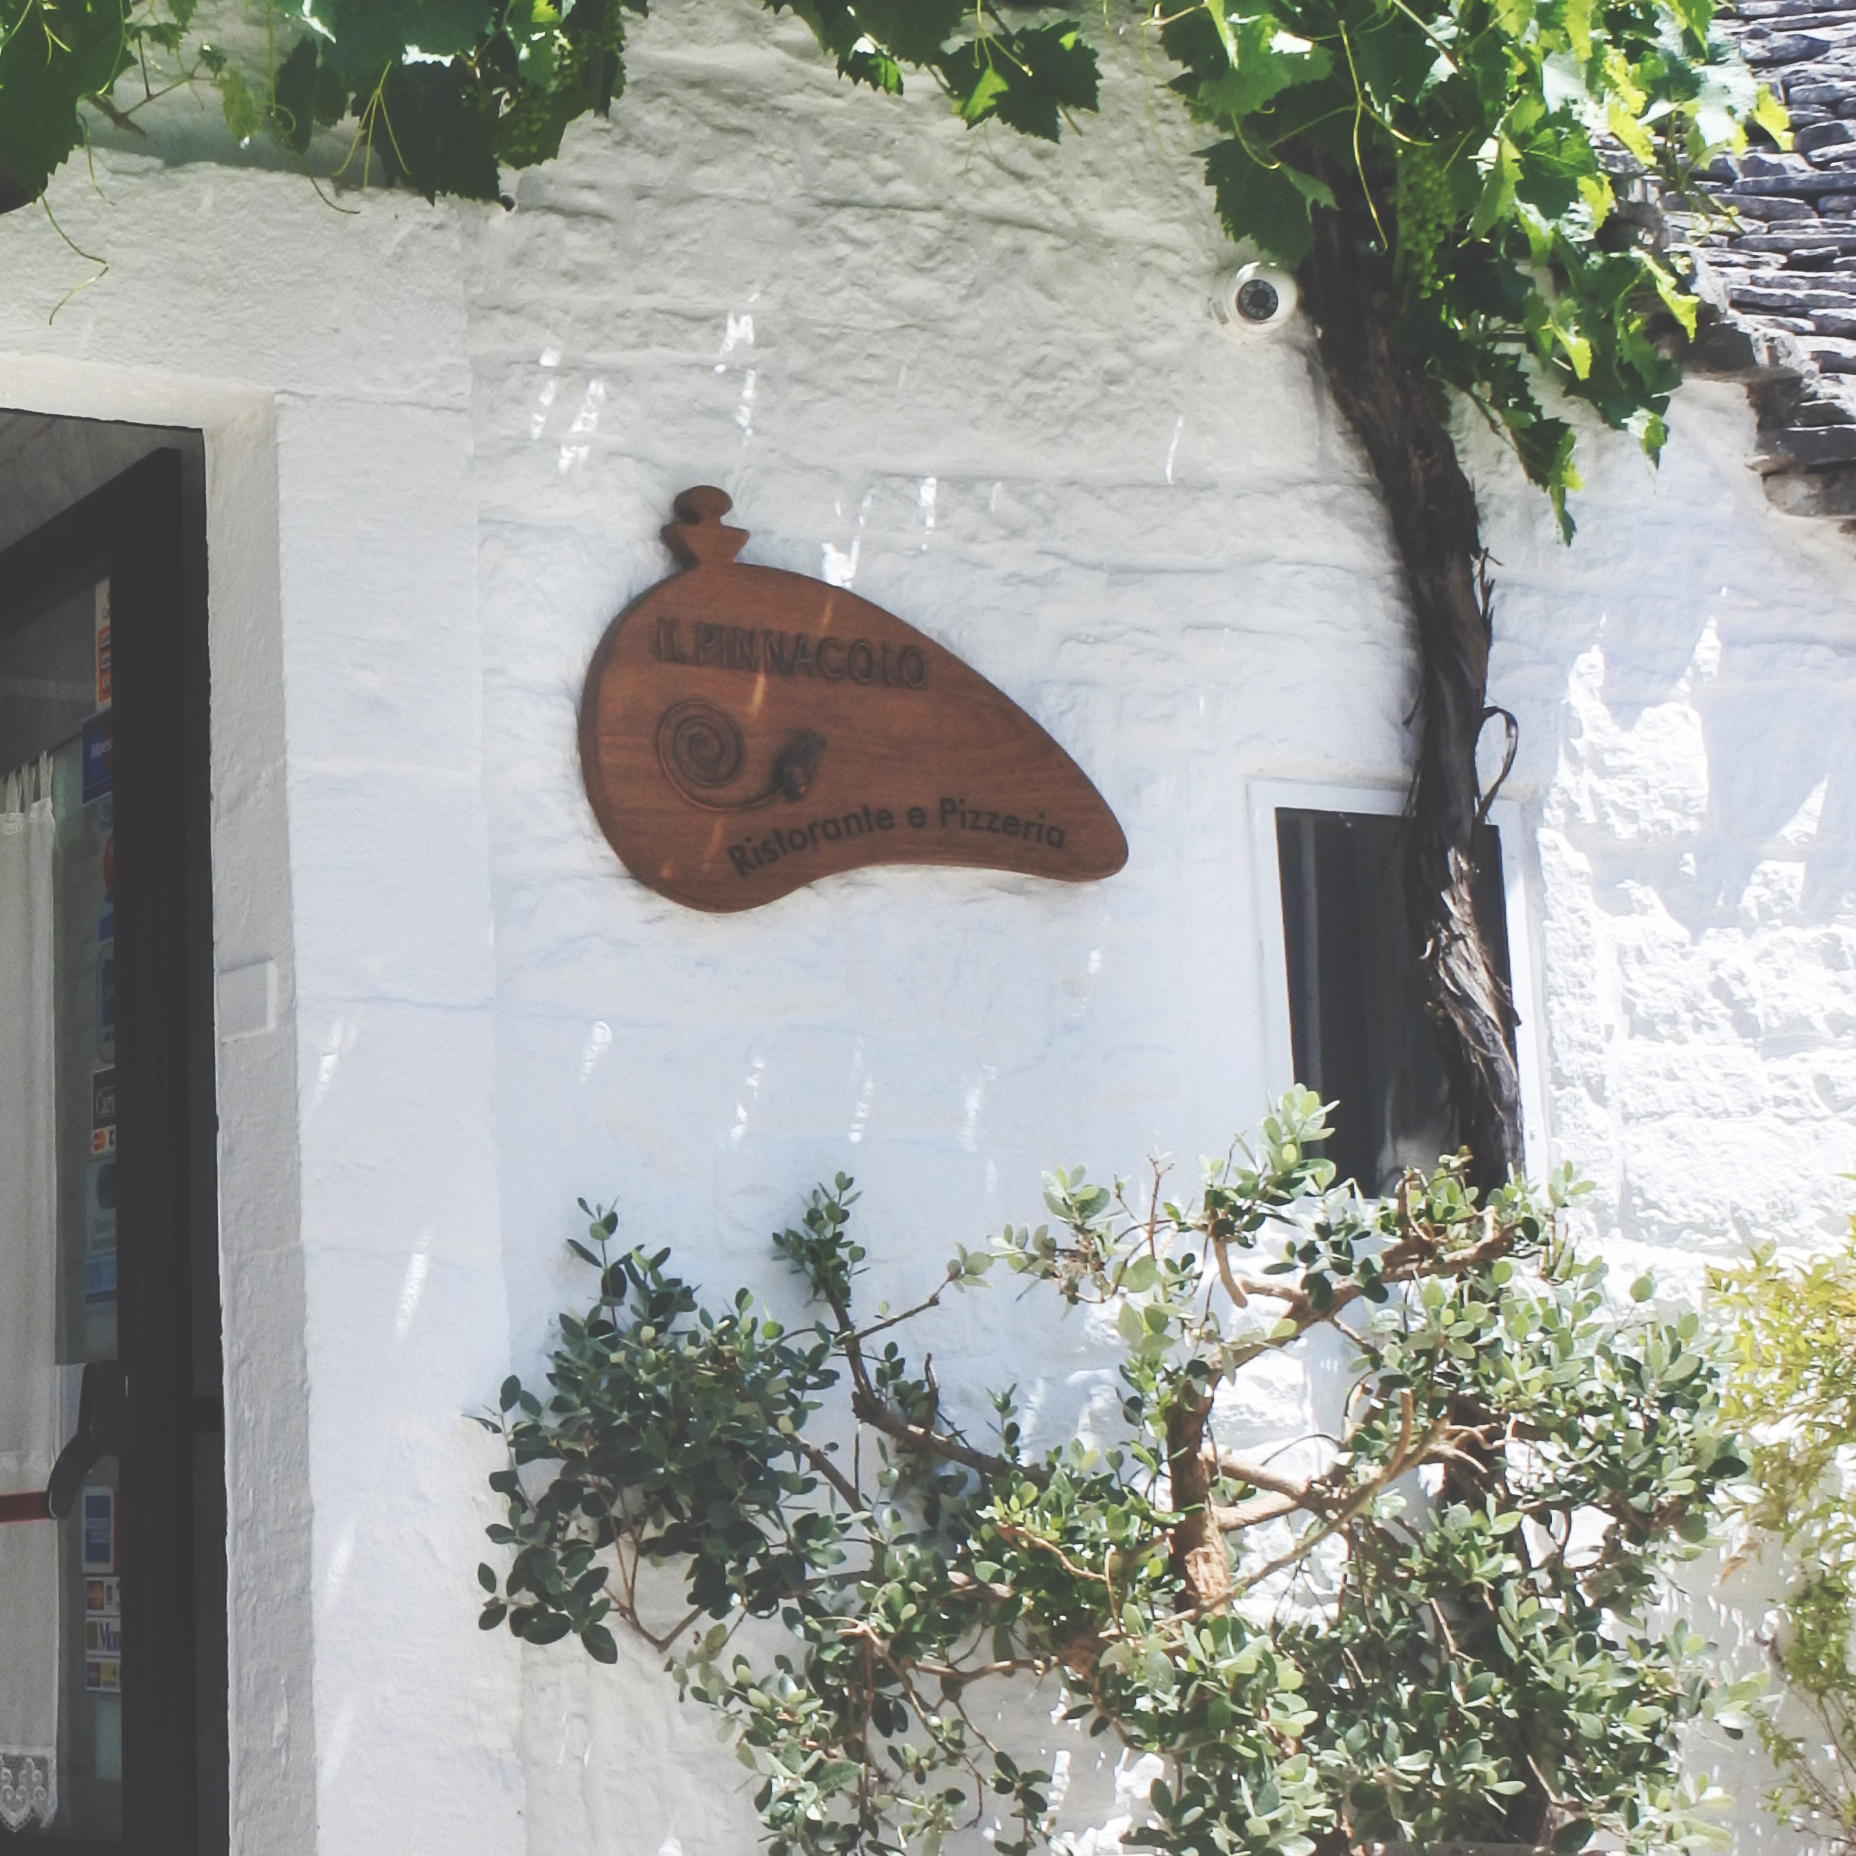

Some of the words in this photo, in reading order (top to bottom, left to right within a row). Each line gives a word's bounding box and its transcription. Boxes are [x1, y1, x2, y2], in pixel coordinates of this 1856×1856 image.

[656, 617, 689, 663] IL
[695, 621, 927, 689] PINNACOLO
[727, 803, 894, 877] Ristorante
[906, 805, 927, 830] e
[938, 797, 1067, 849] Pizzeria
